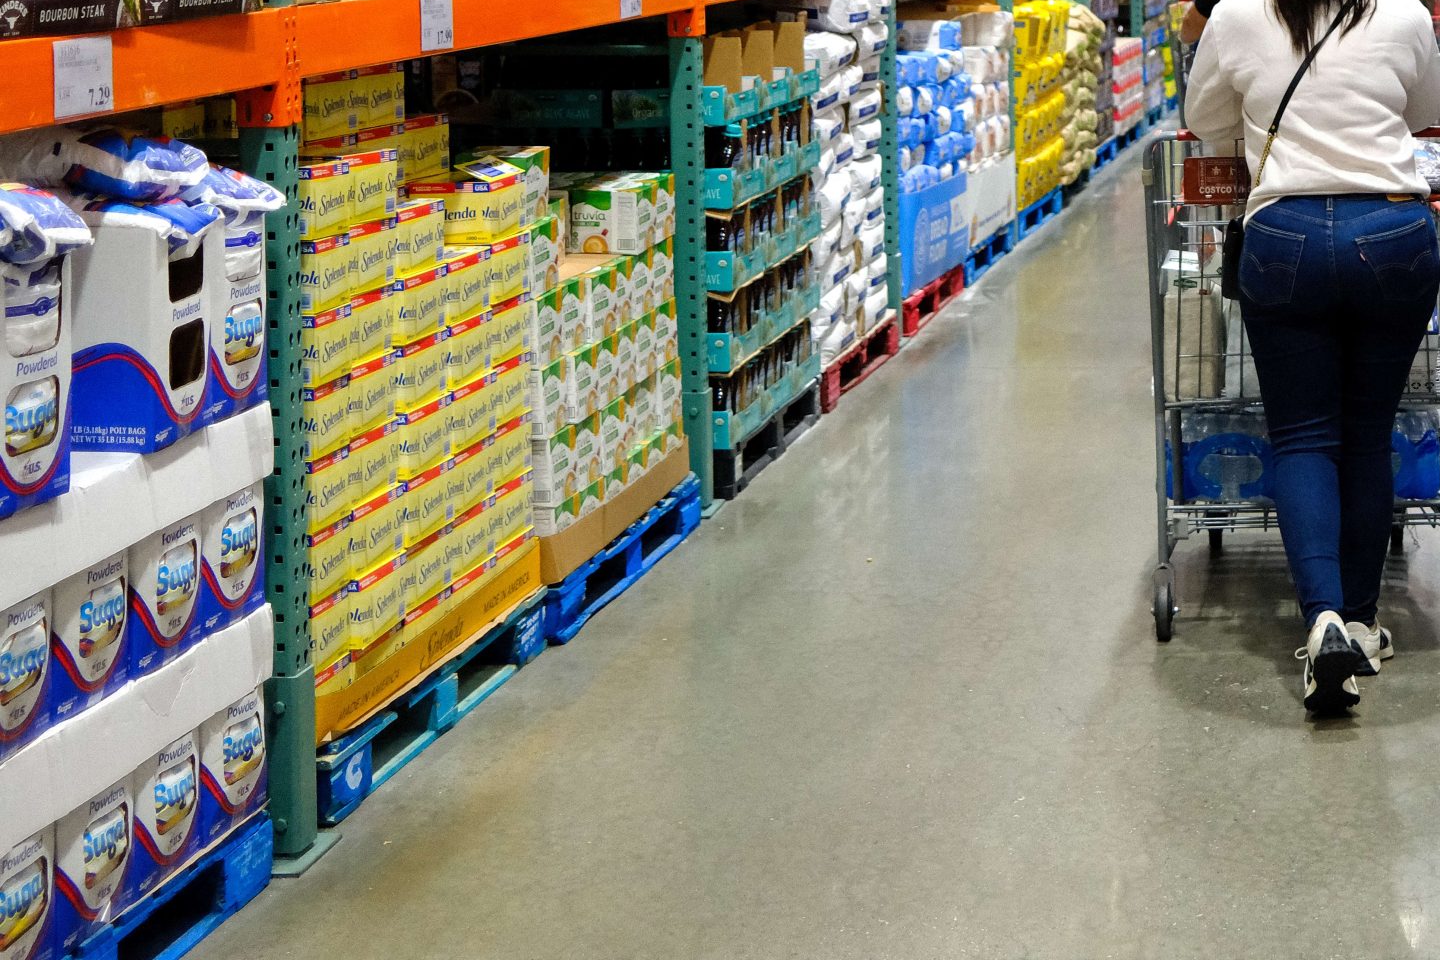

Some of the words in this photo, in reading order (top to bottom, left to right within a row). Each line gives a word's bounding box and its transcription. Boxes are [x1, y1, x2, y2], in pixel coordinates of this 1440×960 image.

[39, 7, 79, 24] BOURBON
[80, 3, 107, 19] STEAK
[87, 85, 111, 107] 7.29
[323, 97, 345, 118] Splenda
[347, 90, 369, 112] Splenda
[371, 87, 392, 109] Splenda
[417, 134, 439, 161] Splenda
[318, 189, 345, 217] Splenda
[357, 177, 383, 203] Splenda
[1198, 185, 1233, 195] COSTCO
[412, 229, 435, 255] Splenda
[361, 246, 384, 273] Splenda
[230, 281, 261, 300] Powdered
[322, 263, 347, 291] Splenda
[461, 278, 486, 304] Splenda
[172, 299, 201, 321] Powdered
[418, 296, 443, 322] Splenda
[361, 320, 384, 344] Splenda
[321, 336, 348, 364] Splenda
[463, 344, 487, 371] Splenda
[15, 352, 58, 378] Powdered
[417, 360, 439, 387] Splenda
[364, 384, 387, 411] Splenda
[320, 408, 344, 436] Splenda
[467, 402, 490, 428] Splenda
[83, 427, 109, 436] (3.18kg)
[109, 427, 127, 435] POLY
[127, 427, 146, 435] BAGS
[85, 436, 97, 444] WT
[105, 436, 115, 444] LB
[421, 427, 444, 453] Splenda
[364, 454, 387, 482] Splenda
[465, 468, 486, 494] Splenda
[319, 479, 346, 508] Splenda
[421, 491, 445, 519] Splenda
[368, 521, 393, 549] Splenda
[464, 527, 486, 555] Splenda
[87, 558, 124, 585] Powdered
[319, 550, 346, 581] Splenda
[418, 556, 442, 585] Splenda
[375, 591, 400, 618] Splenda
[319, 621, 345, 651] Splenda
[1, 835, 43, 873] Powdered
